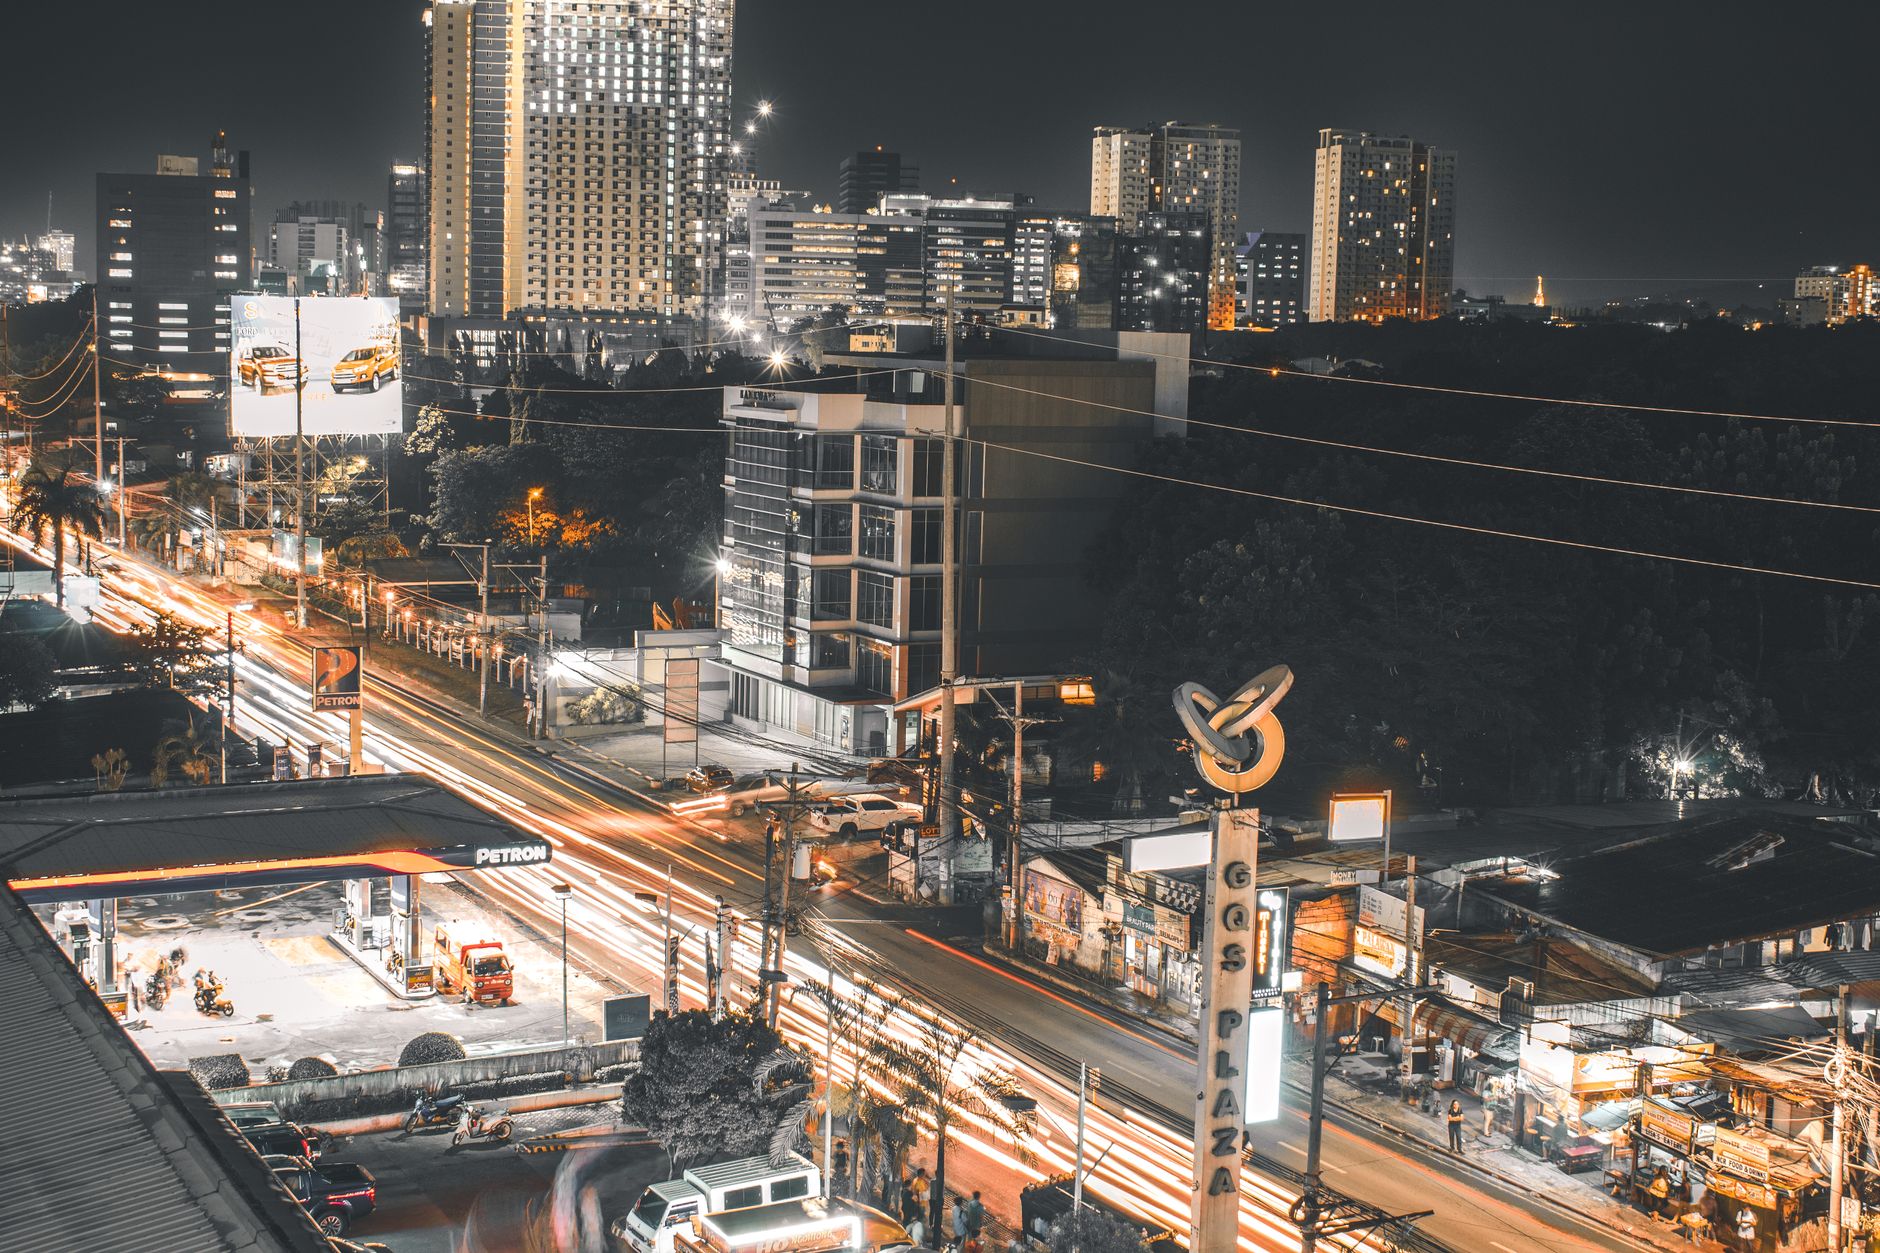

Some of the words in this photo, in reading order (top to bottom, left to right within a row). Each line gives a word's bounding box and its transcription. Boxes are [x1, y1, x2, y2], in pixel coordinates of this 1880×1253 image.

[316, 696, 360, 706] PETRON
[476, 845, 547, 864] PETRON
[1331, 871, 1356, 879] MONEY
[1127, 915, 1145, 928] BEAUTY
[1221, 861, 1251, 972] GQS
[1209, 1009, 1243, 1196] PLAZA
[1729, 1160, 1743, 1173] FOOD
[1748, 1168, 1767, 1180] DRINKS
